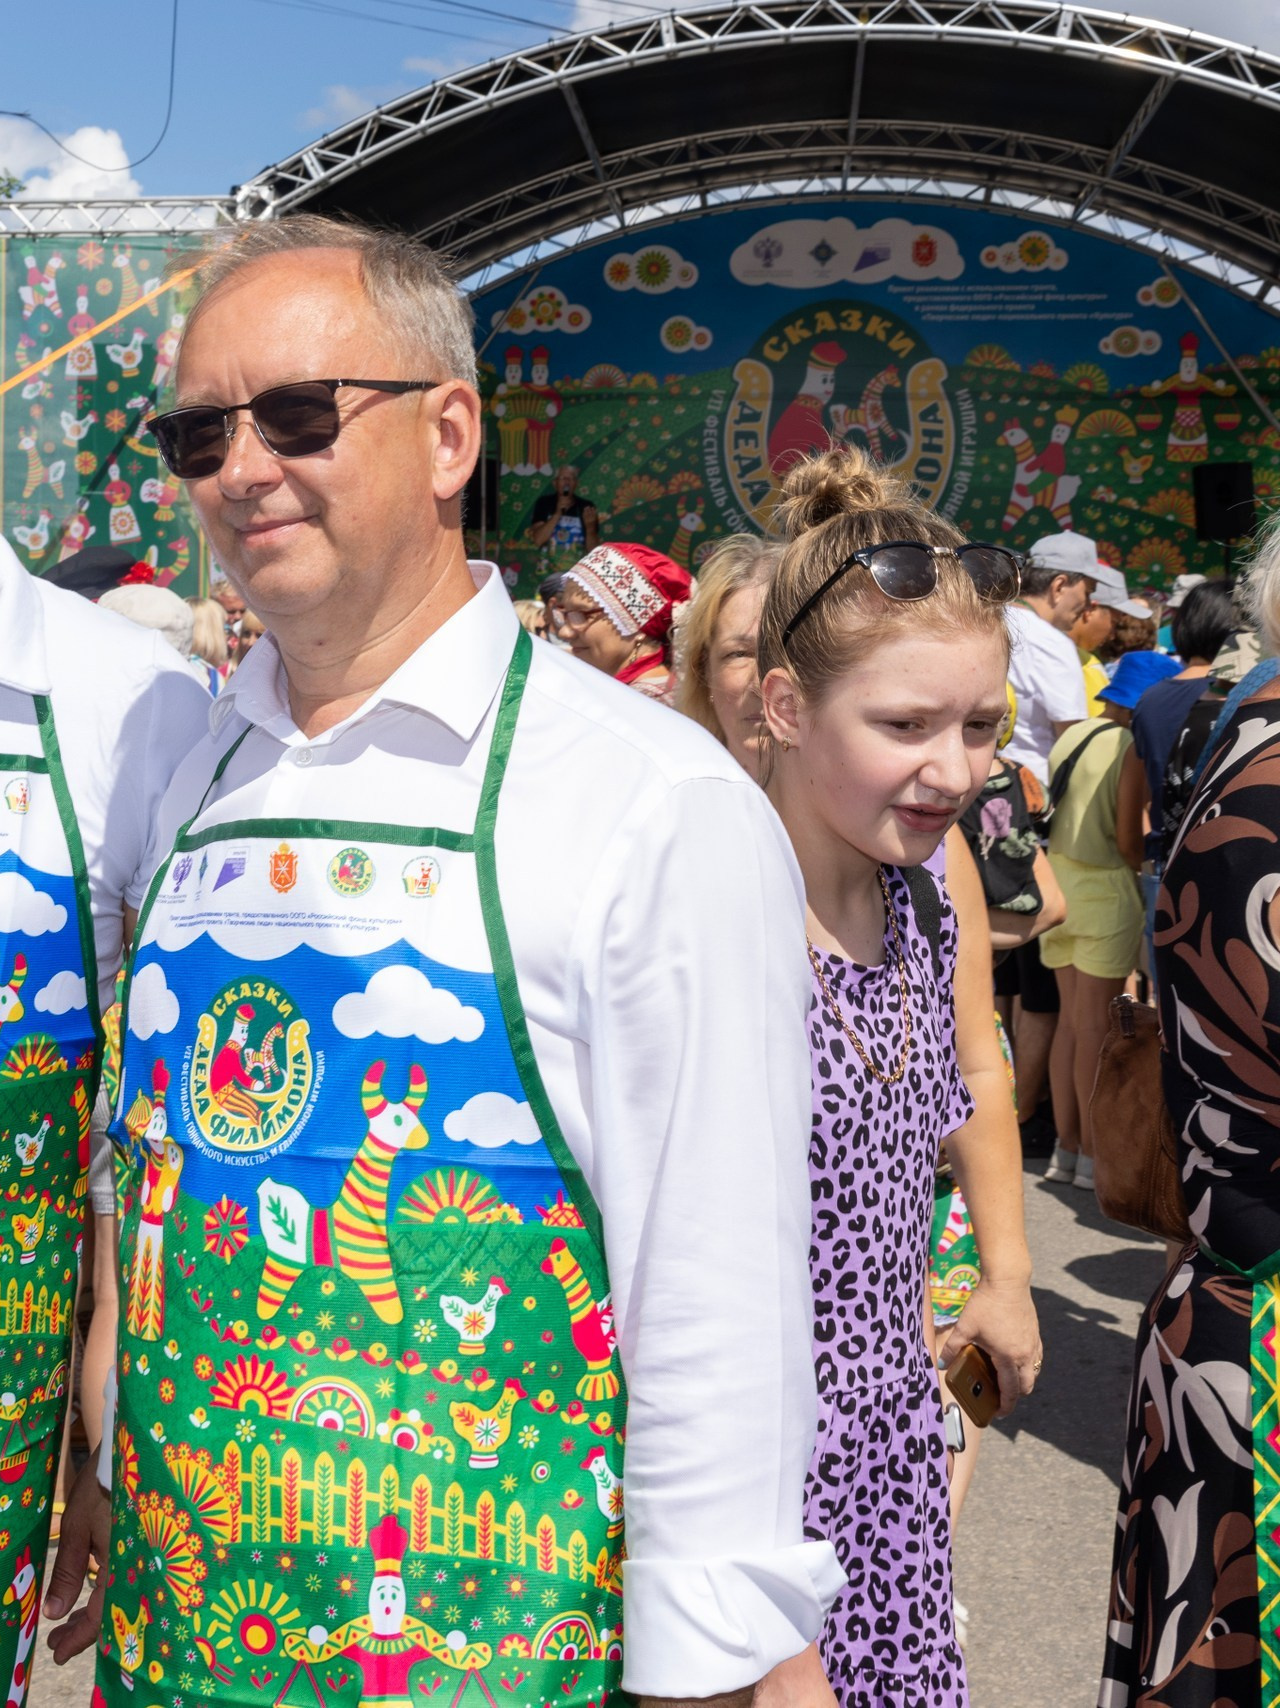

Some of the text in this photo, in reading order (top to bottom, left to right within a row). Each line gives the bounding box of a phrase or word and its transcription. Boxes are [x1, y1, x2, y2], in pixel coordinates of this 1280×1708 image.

[763, 309, 916, 362] СКАЗКИ
[733, 400, 773, 507] ДЕДА
[955, 387, 978, 467] ИГРУШКИ
[702, 415, 726, 508] ФЕСТИВАЛЬ
[212, 982, 294, 1019] СКАЗКИ
[180, 1061, 191, 1122] ФЕСТИВАЛЬ
[193, 1041, 309, 1146] ДЕДА ФИЛИМОНА
[309, 1050, 326, 1102] ИГРУШКИ
[185, 1121, 223, 1163] ГОНЧАРНОГО
[224, 1151, 270, 1167] ИСКУССТВА
